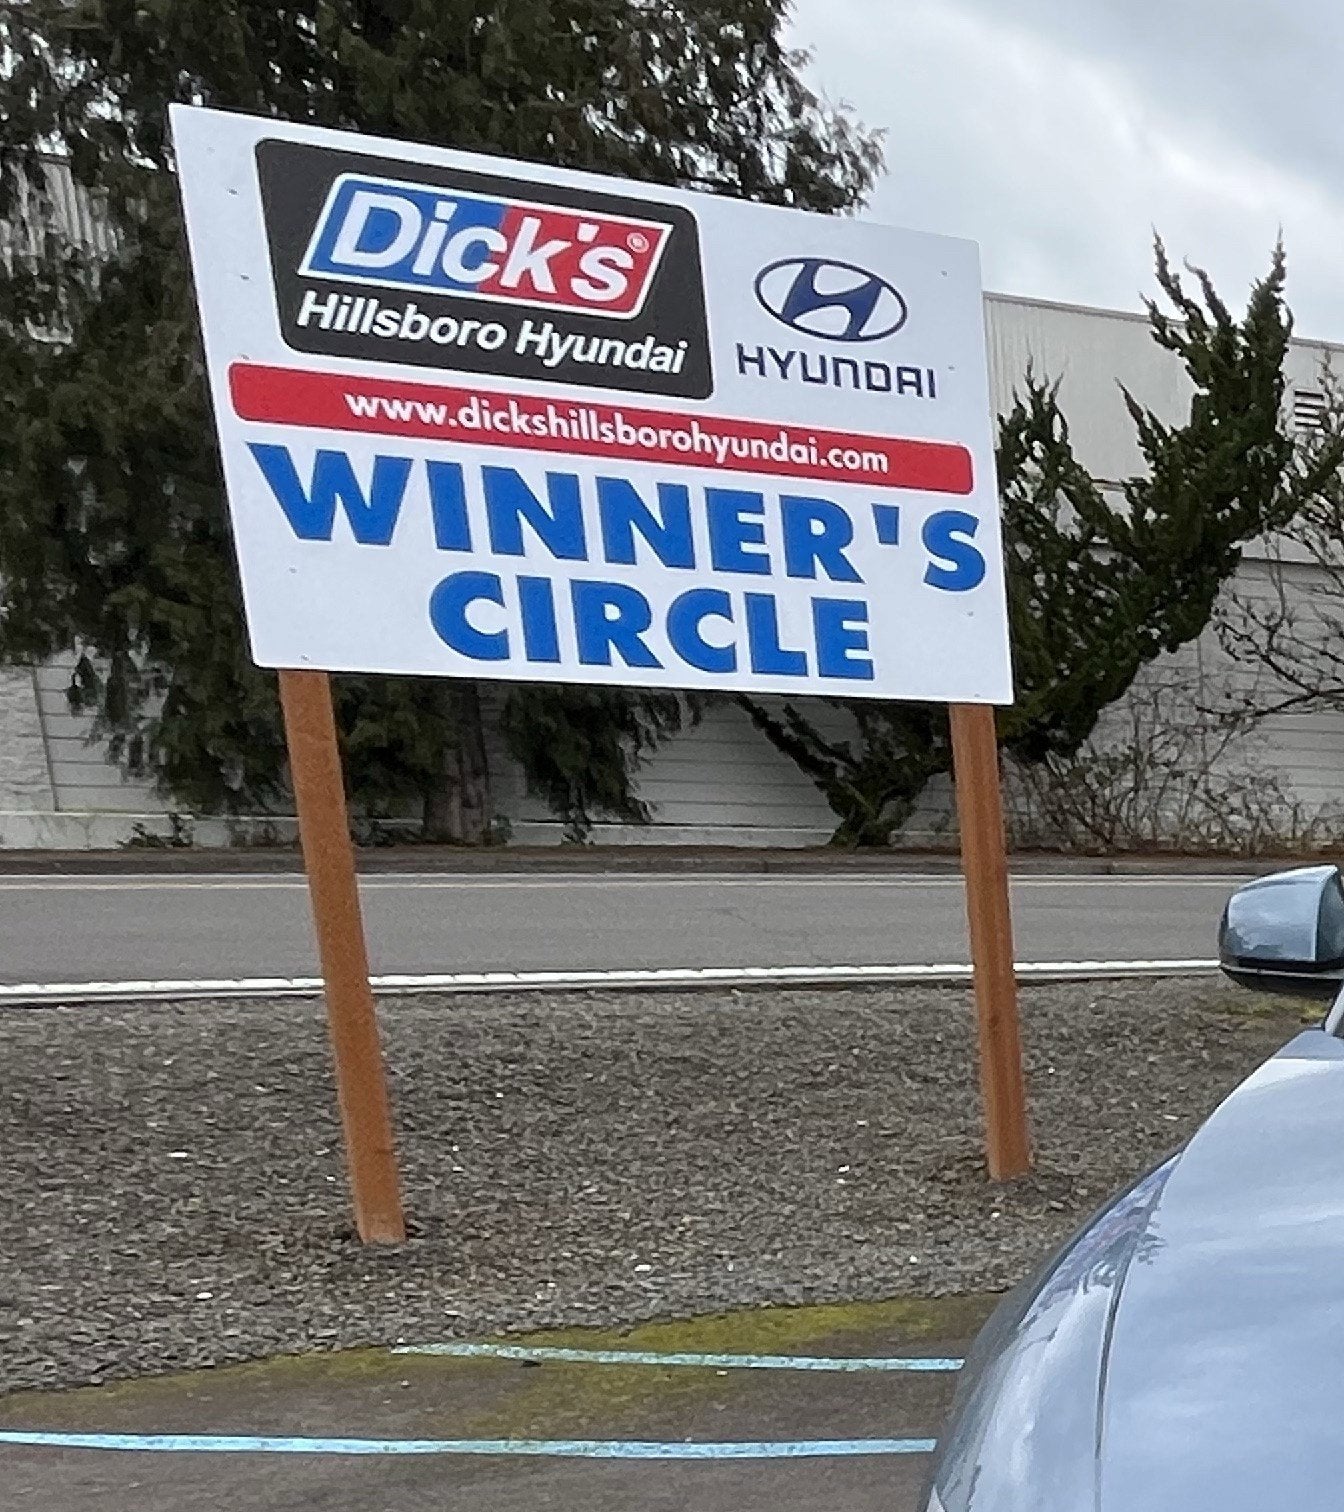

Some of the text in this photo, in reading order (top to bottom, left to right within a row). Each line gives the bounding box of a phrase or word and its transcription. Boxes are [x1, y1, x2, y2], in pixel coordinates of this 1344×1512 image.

[330, 190, 635, 302] Dick's
[297, 291, 688, 375] Hillsboro Hyundai
[737, 343, 937, 399] HYUNDAI
[344, 393, 889, 473] www.dickshillsborohyundai.com
[247, 443, 986, 592] WINNER'S
[429, 571, 876, 680] CIRCLE
